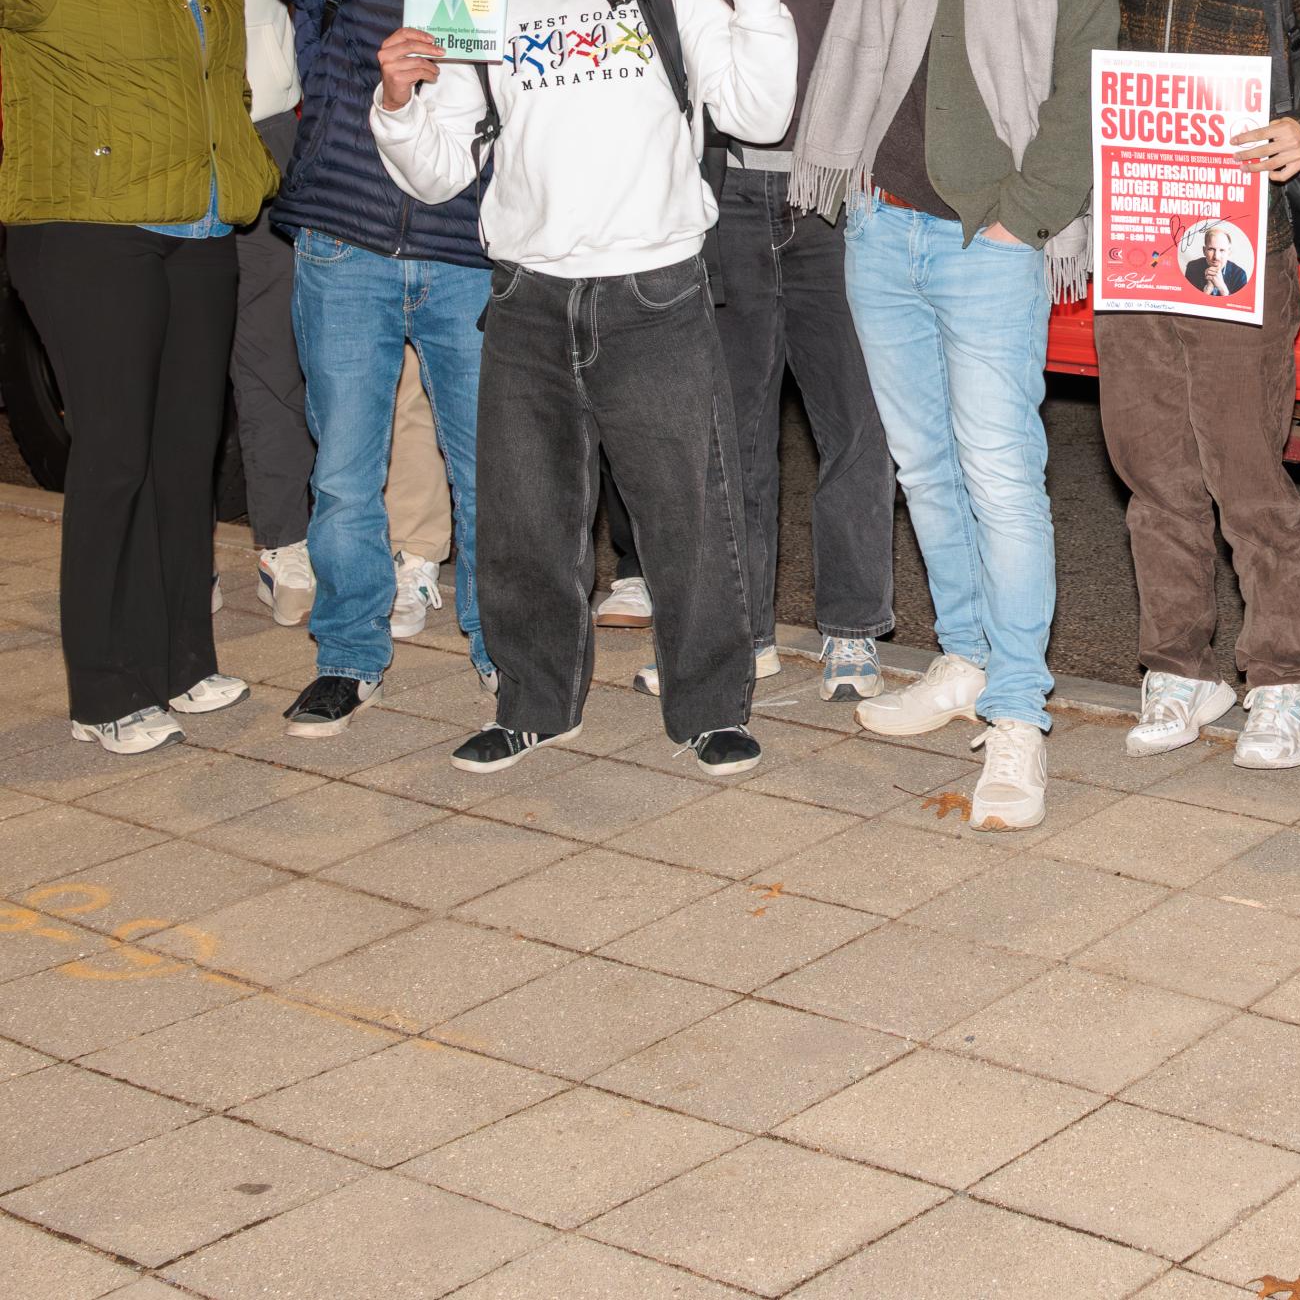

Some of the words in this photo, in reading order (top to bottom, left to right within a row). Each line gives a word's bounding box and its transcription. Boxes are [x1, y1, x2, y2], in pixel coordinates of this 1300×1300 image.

[519, 15, 568, 32] WEST
[580, 9, 640, 23] COAST
[447, 34, 497, 53] Bregman
[522, 67, 645, 91] MARATHON
[1101, 107, 1225, 147] SUCCESS
[1120, 151, 1145, 159] TWO-TIME
[1160, 153, 1173, 161] YORK
[1174, 154, 1189, 162] TIMES
[1190, 155, 1222, 164] BESTSELLING
[1111, 161, 1120, 177] A
[1123, 162, 1216, 183] CONVERSATION
[1220, 168, 1252, 186] WITH
[1111, 178, 1158, 196] RUTGER
[1162, 180, 1224, 201] BREGMAN
[1227, 186, 1245, 203] ON
[1111, 196, 1156, 213] MORAL
[1160, 198, 1221, 218] AMBITION
